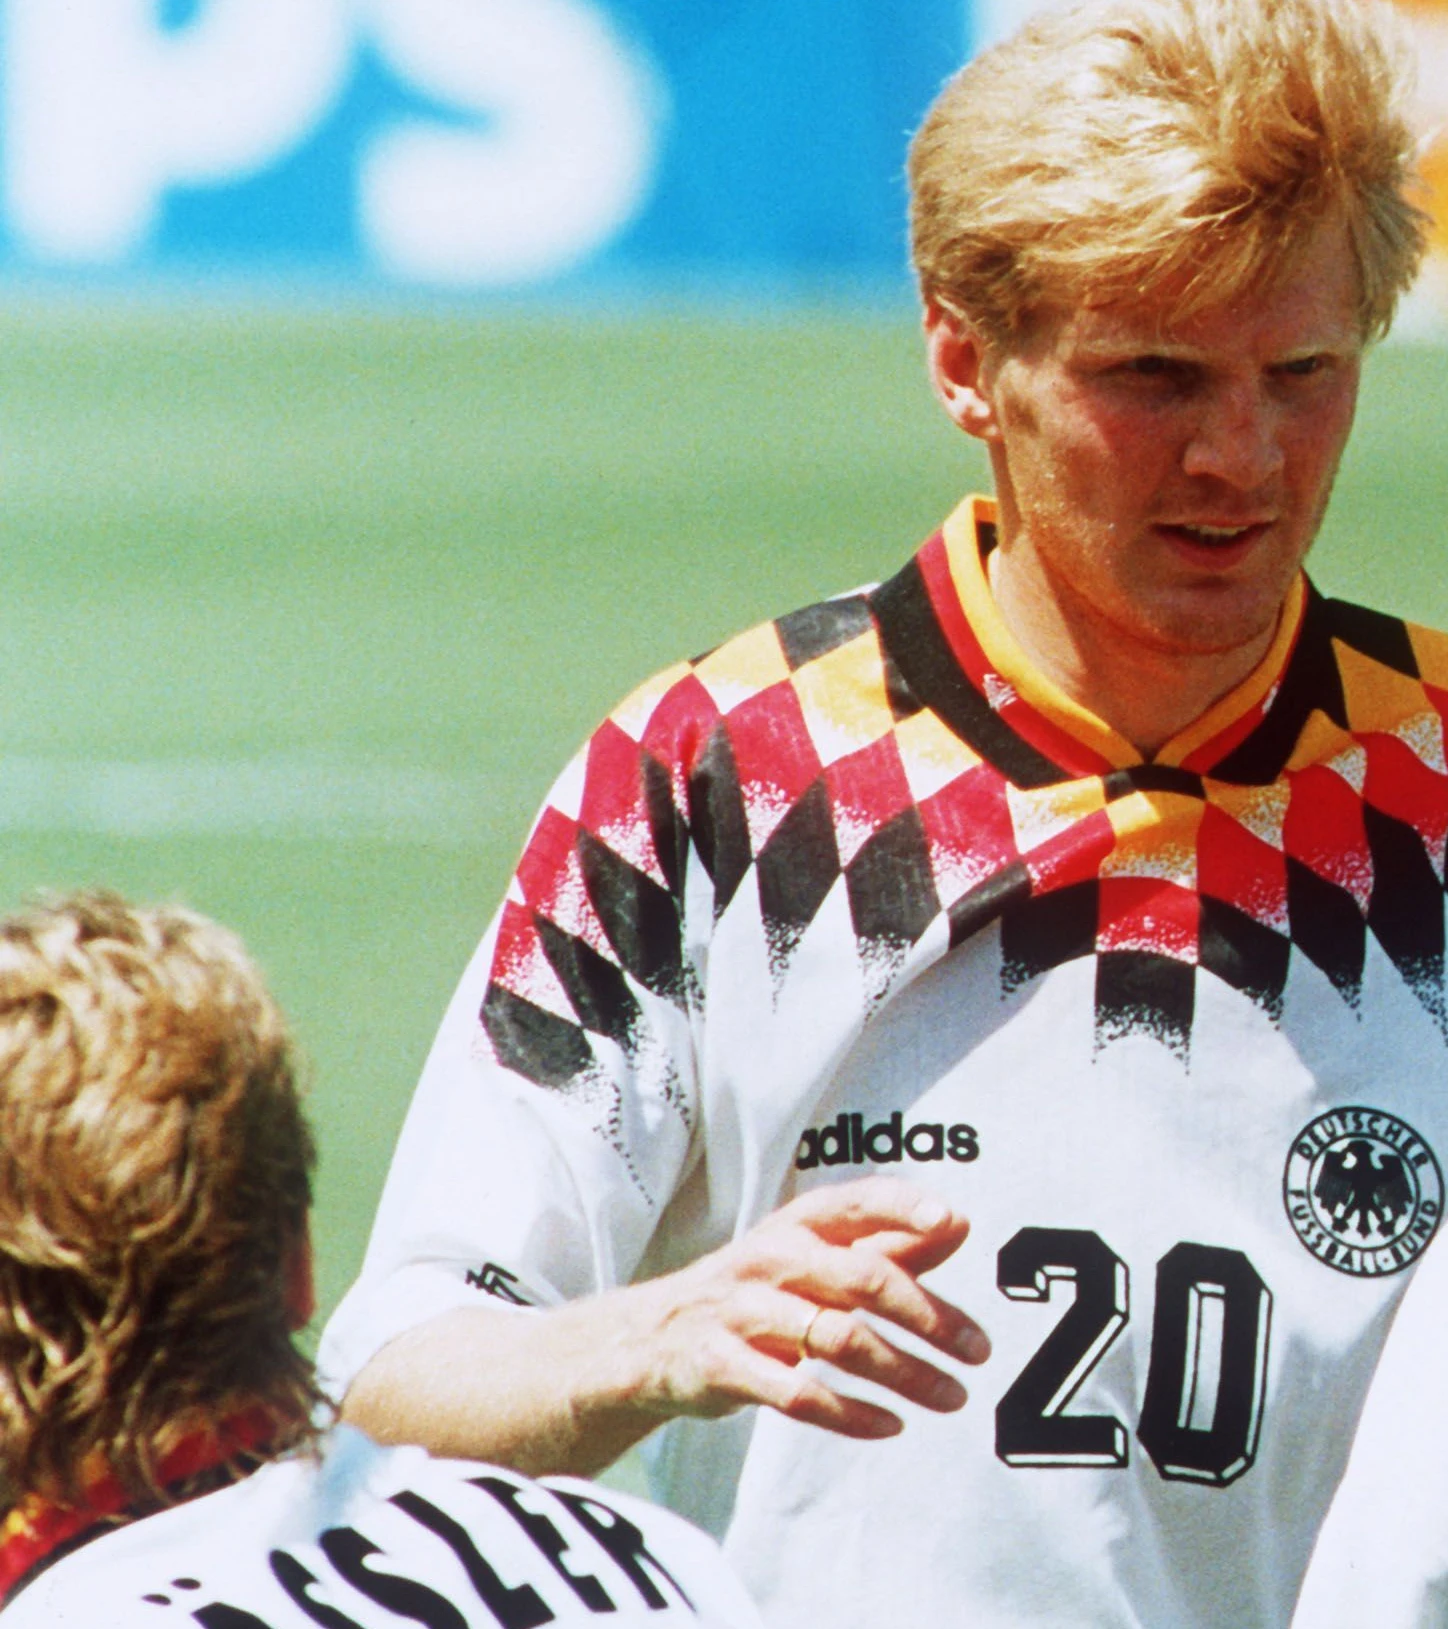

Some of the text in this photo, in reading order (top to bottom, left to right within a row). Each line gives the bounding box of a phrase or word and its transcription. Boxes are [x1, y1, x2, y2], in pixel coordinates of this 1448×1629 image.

[794, 1110, 981, 1171] adidas
[1296, 1112, 1429, 1172] DEUTSCHER
[994, 1226, 1274, 1489] 20
[140, 1476, 698, 1629] SSLER
